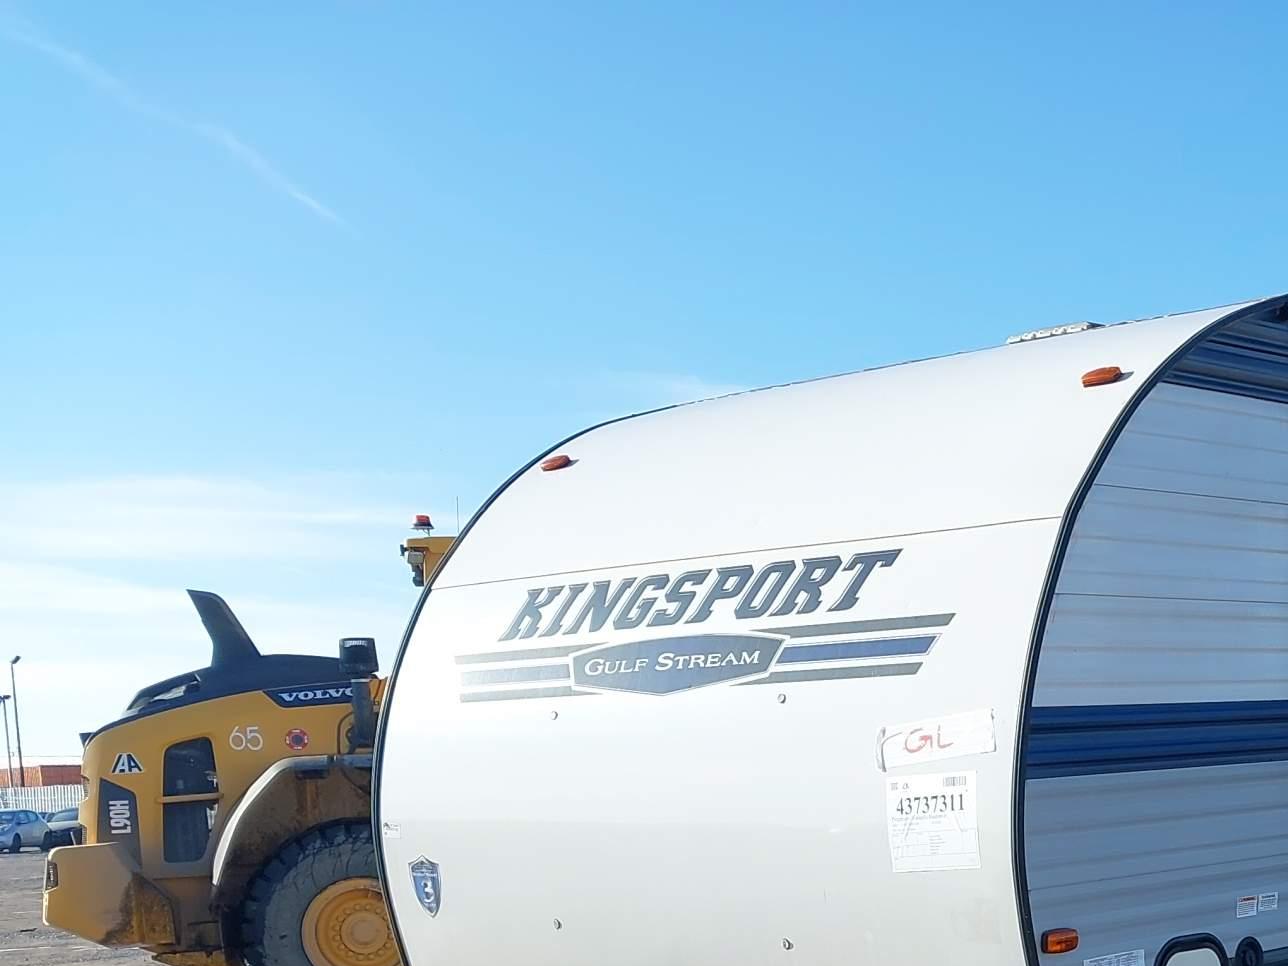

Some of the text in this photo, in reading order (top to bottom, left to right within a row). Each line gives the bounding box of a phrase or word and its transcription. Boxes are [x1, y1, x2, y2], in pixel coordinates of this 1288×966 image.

[498, 548, 903, 642] KINGSPORT
[584, 651, 761, 676] GULF STREAM
[229, 725, 263, 750] 65
[896, 793, 965, 815] 43737311
[108, 800, 131, 834] L90H
